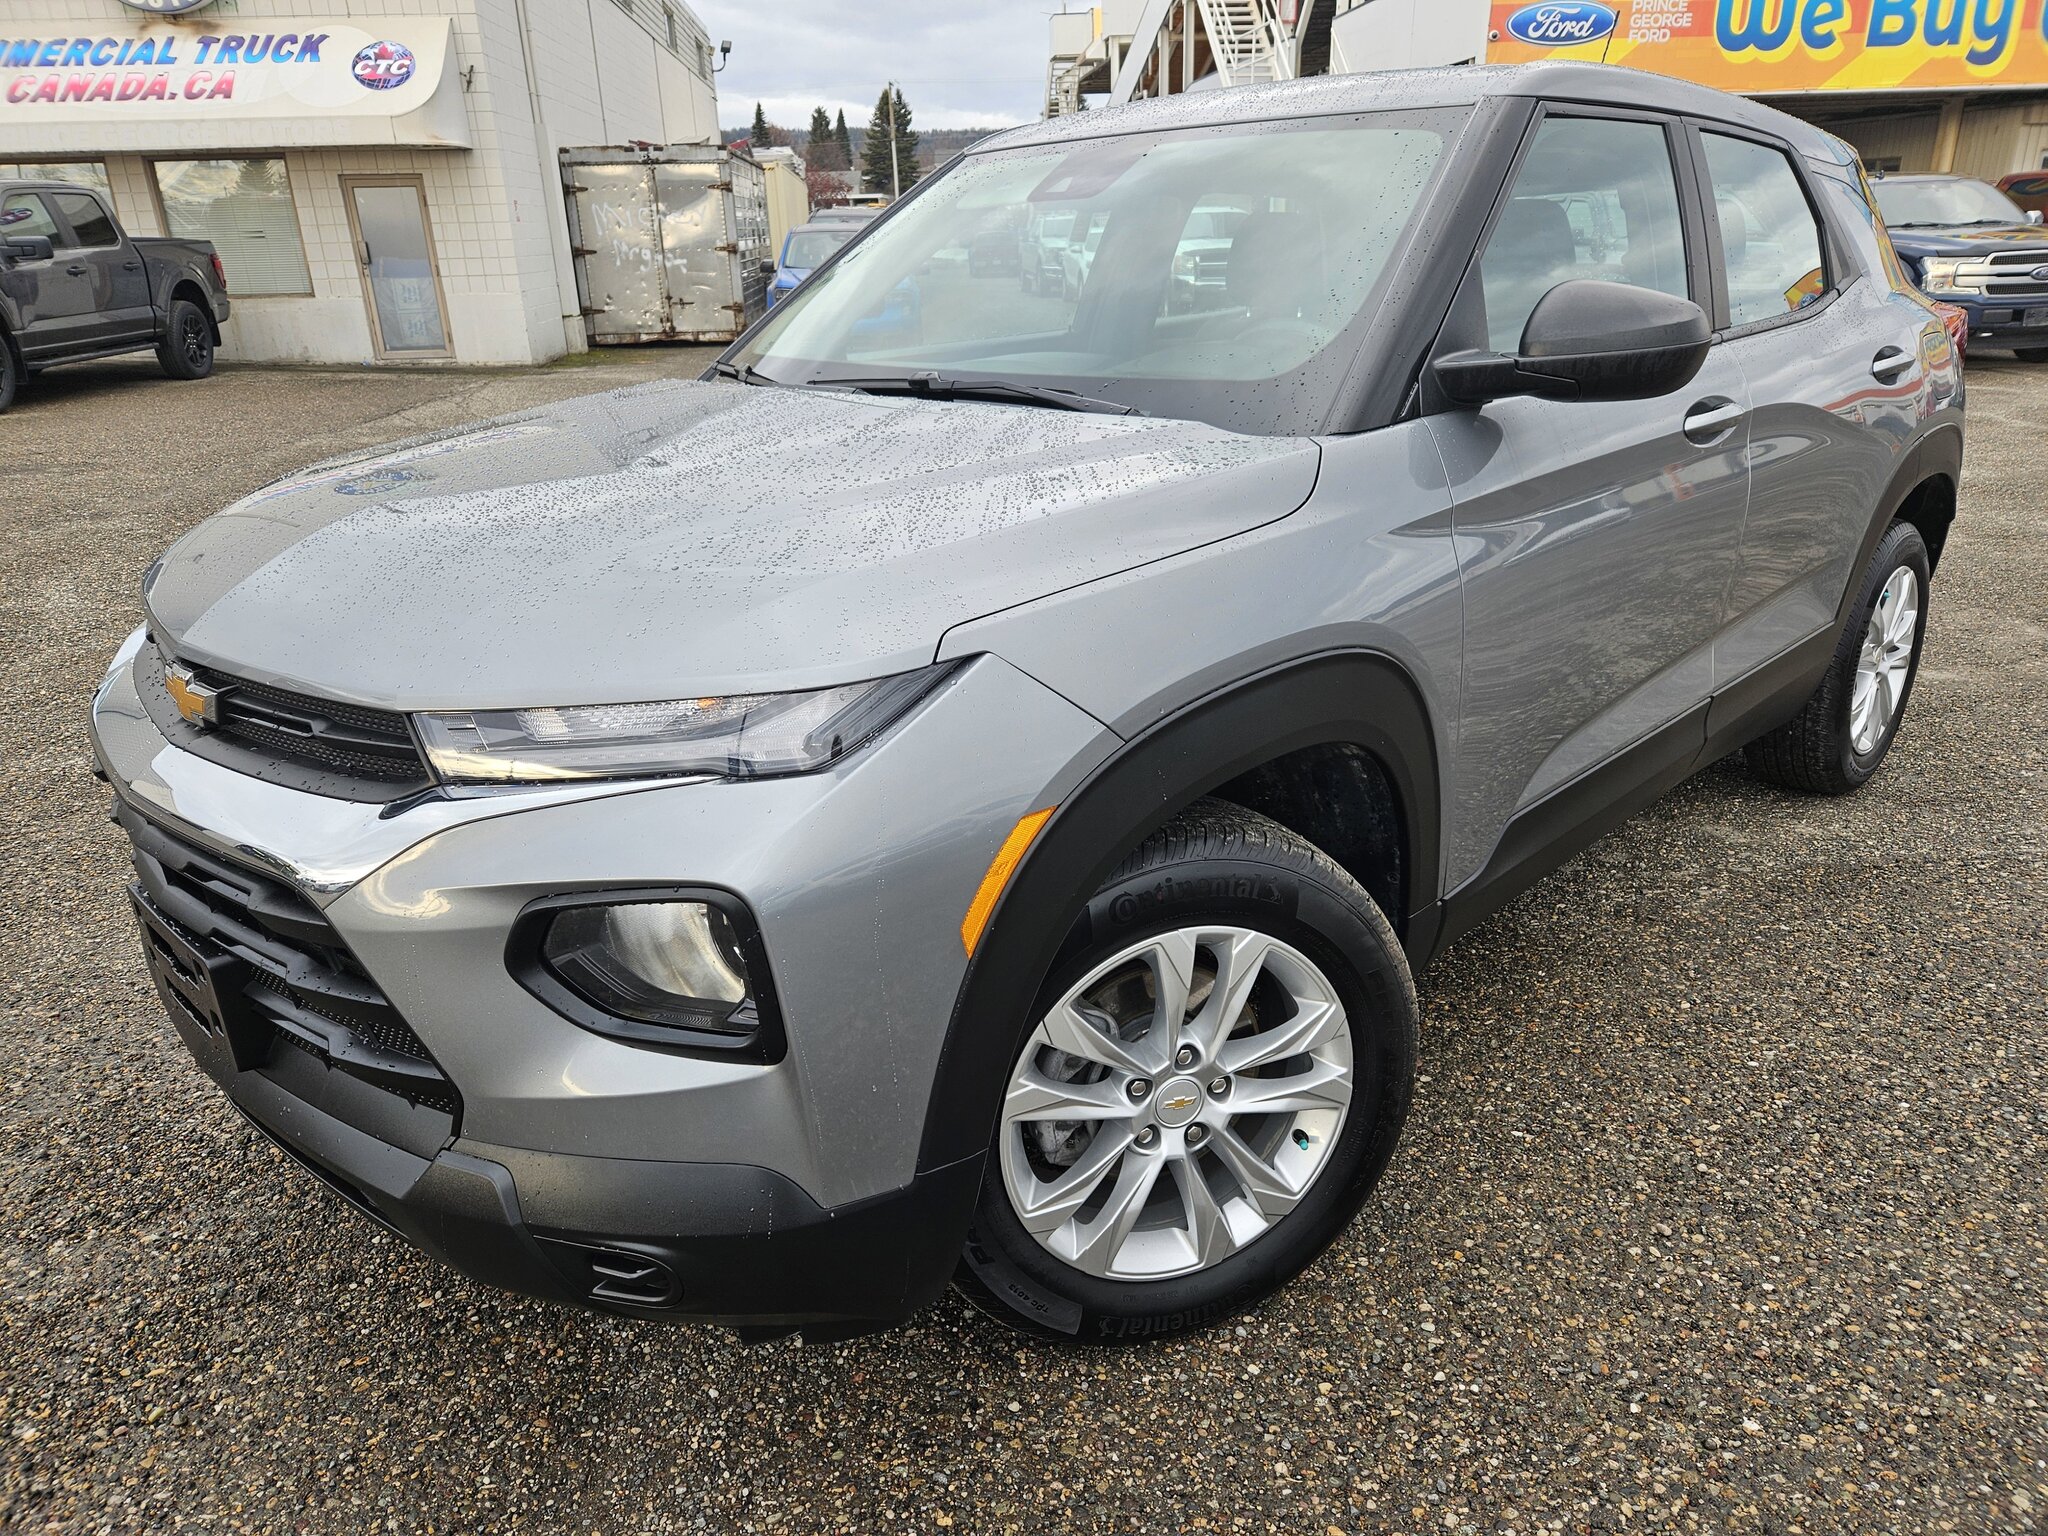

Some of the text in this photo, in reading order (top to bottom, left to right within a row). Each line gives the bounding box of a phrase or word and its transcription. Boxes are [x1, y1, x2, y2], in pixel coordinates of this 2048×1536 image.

[1631, 0, 1688, 12] PRINCE
[1527, 6, 1597, 38] Ford
[1629, 13, 1692, 28] GEORGE
[1627, 28, 1671, 43] FORD
[1715, 0, 1845, 52] We
[1866, 0, 2014, 67] Buy
[194, 34, 330, 64] TRUCK
[354, 59, 411, 75] CTC
[7, 70, 235, 103] CANADA.CA
